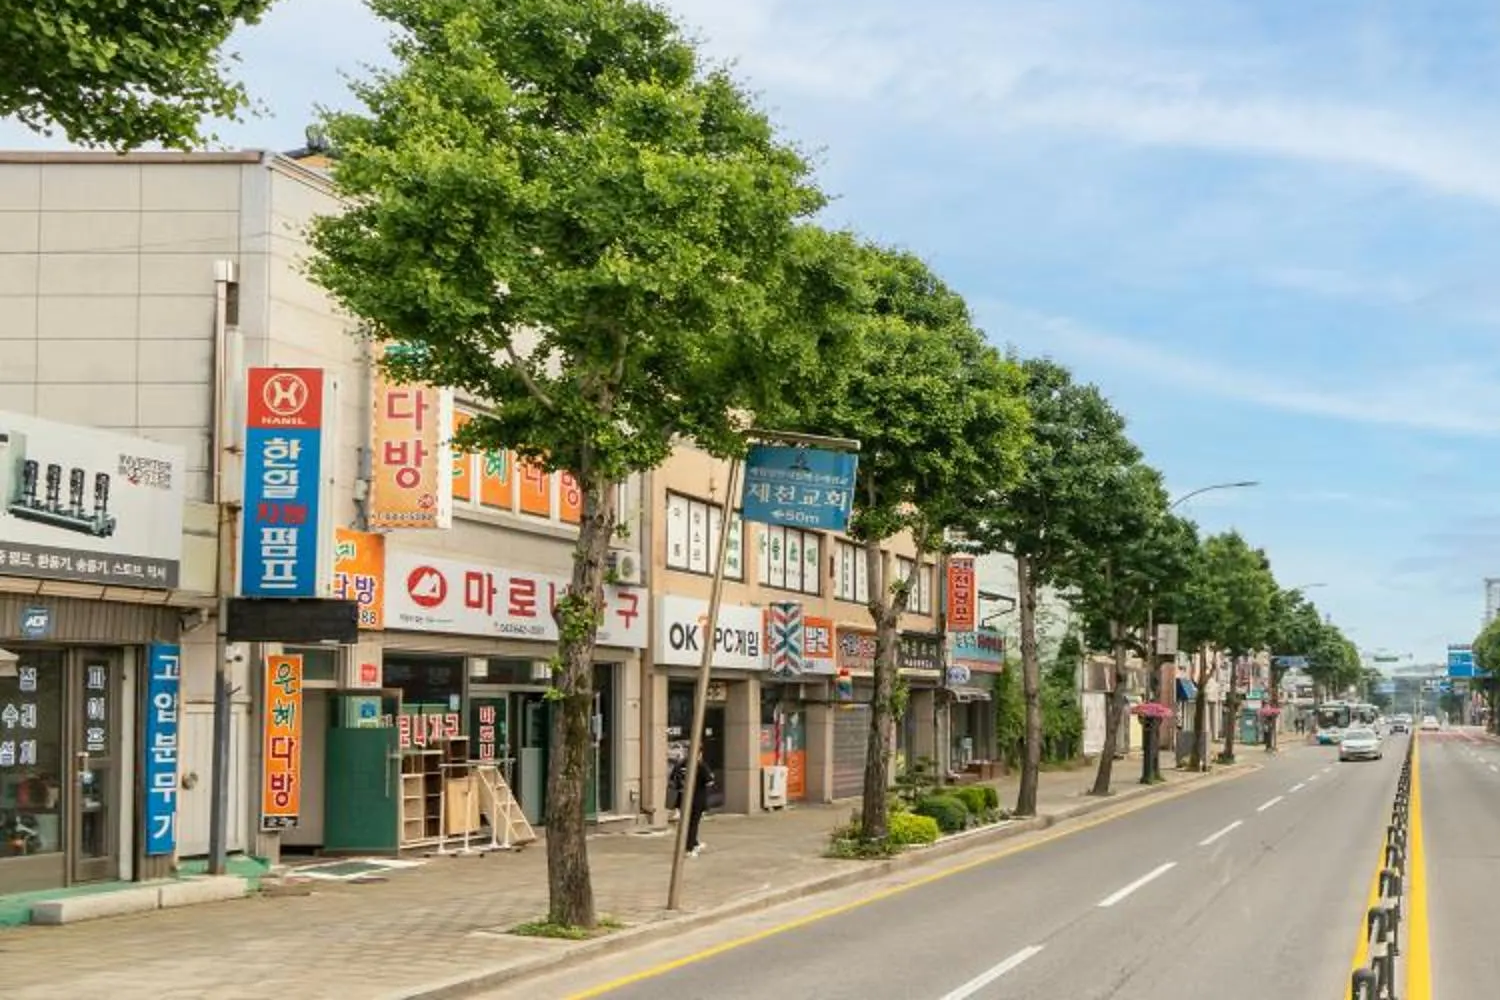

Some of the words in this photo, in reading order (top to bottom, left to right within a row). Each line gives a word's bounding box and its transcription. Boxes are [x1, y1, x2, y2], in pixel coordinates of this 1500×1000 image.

[261, 416, 307, 425] HANIL
[384, 390, 429, 489] 다방
[669, 621, 699, 651] OK
